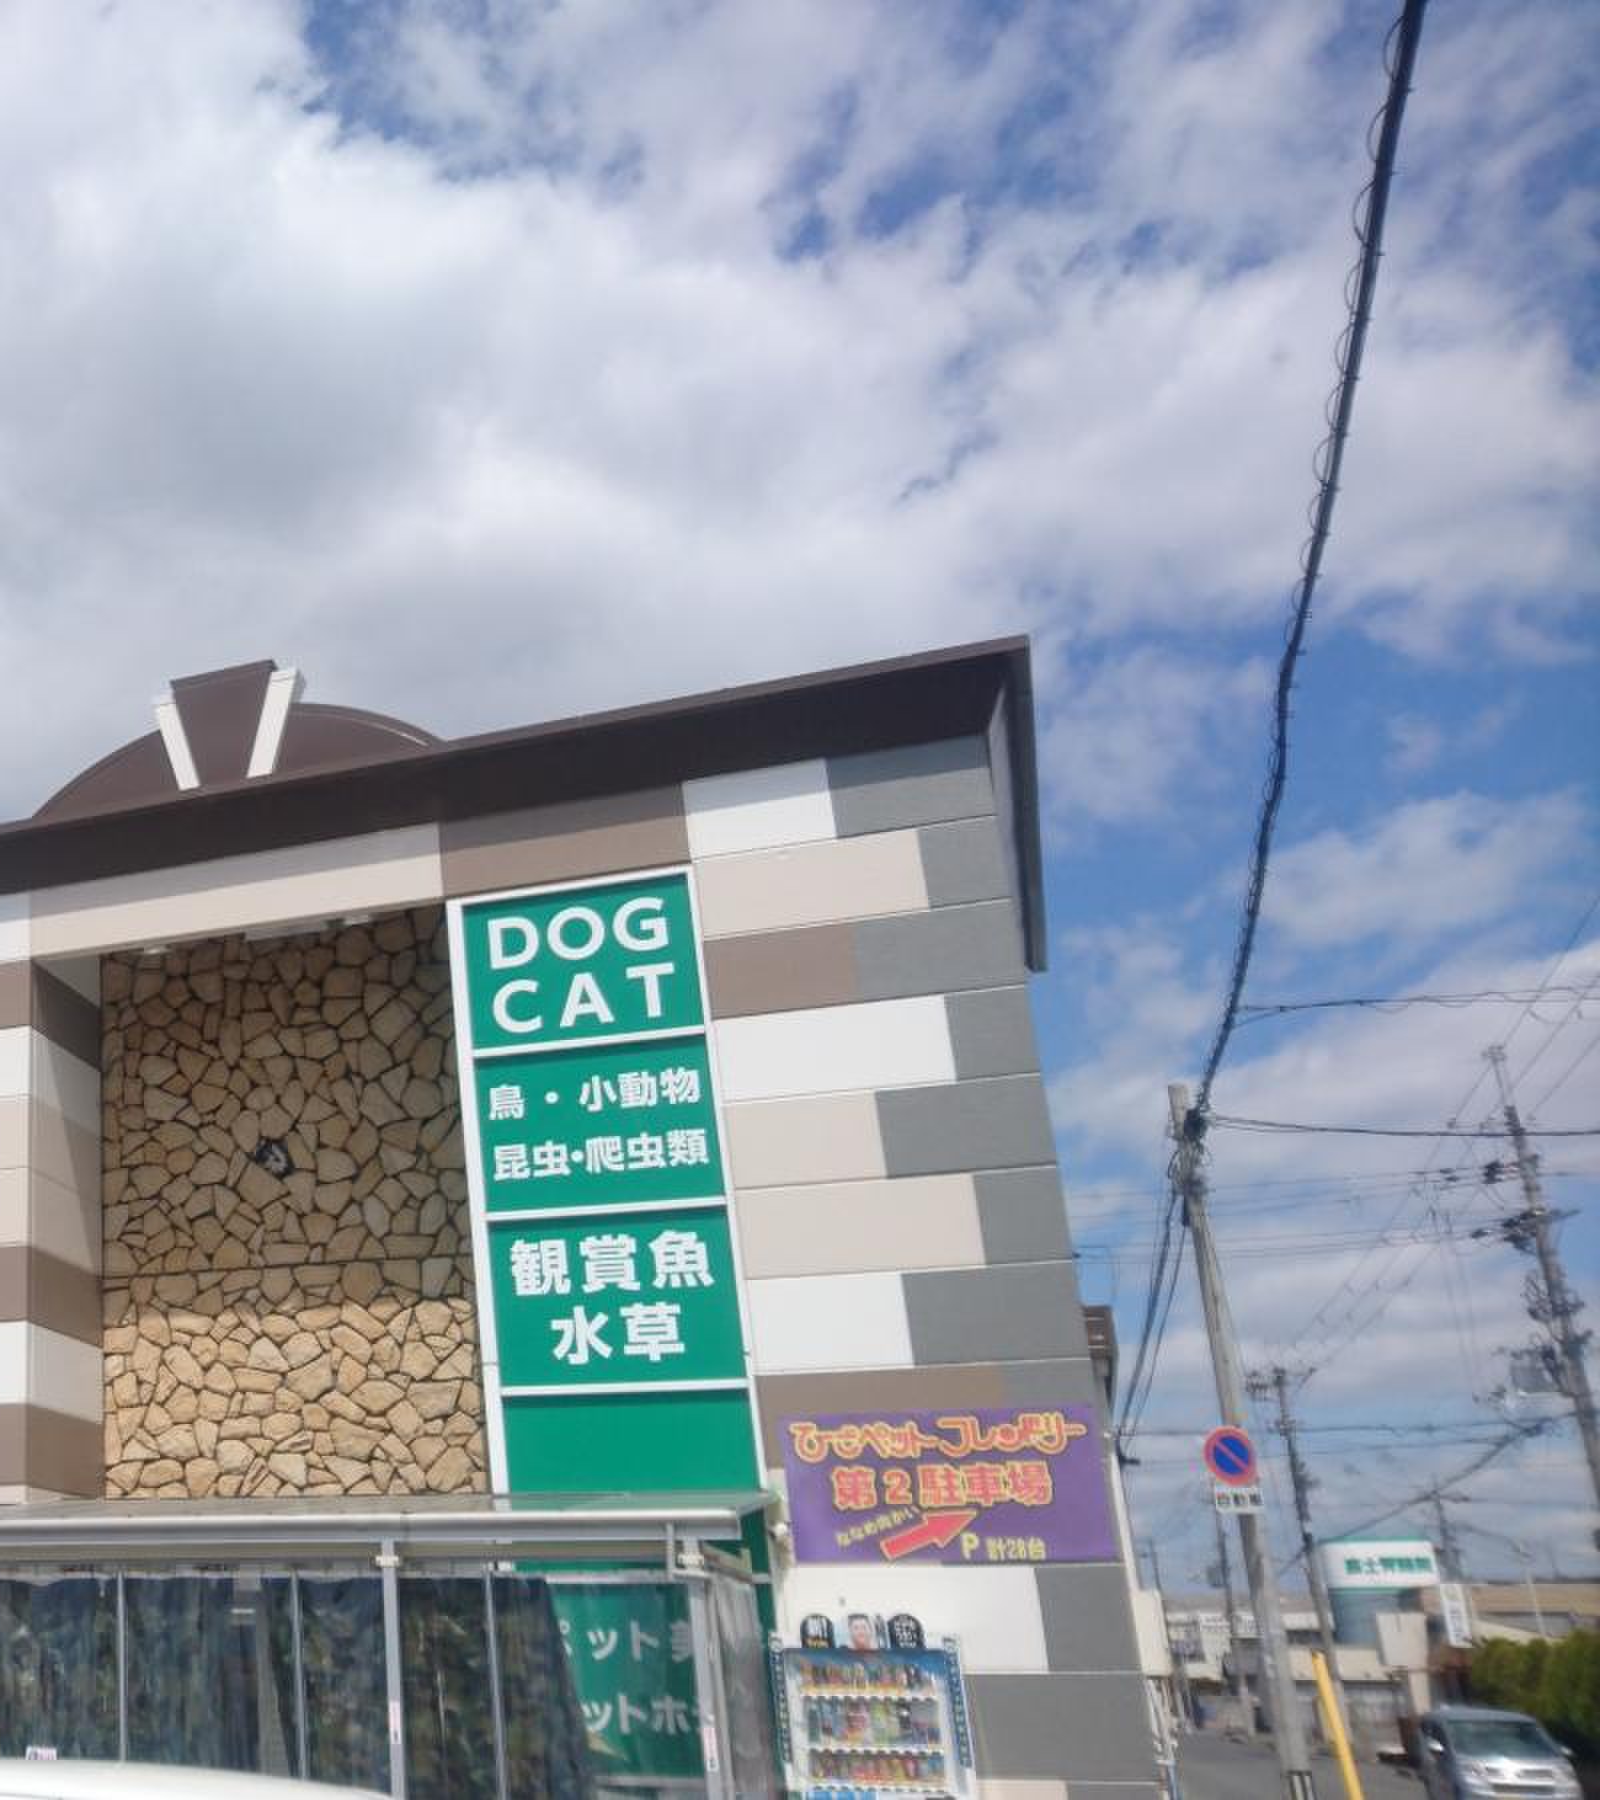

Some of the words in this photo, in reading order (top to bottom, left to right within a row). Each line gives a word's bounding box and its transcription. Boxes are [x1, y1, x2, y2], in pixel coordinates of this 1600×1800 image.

[487, 897, 670, 969] DOG
[492, 963, 675, 1033] CAT
[493, 1129, 709, 1181] 昆虫・爬虫類
[510, 1231, 714, 1297] 観賞魚
[551, 1302, 686, 1364] 水草
[961, 1532, 980, 1560] P
